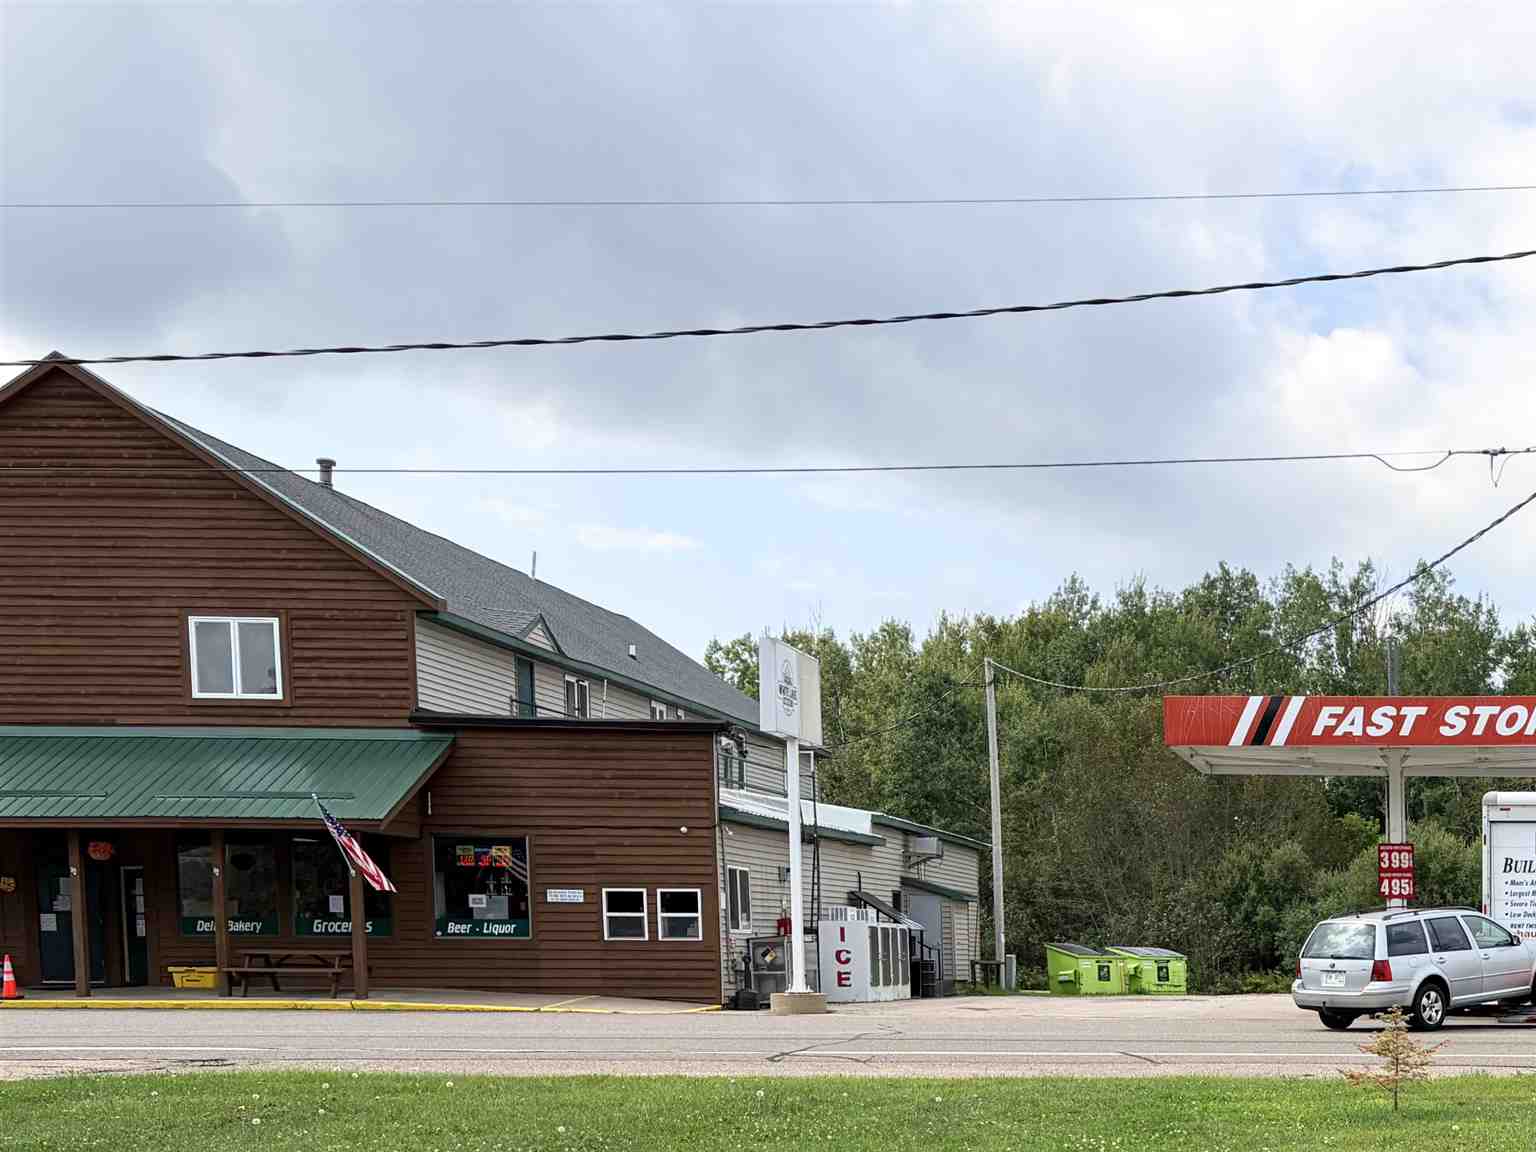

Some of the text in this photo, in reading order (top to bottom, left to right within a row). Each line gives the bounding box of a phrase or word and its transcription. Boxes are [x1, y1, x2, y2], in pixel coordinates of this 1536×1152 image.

[1311, 705, 1428, 737] FAST
[447, 922, 517, 936] Beer Liquor
[835, 926, 852, 988] ICE
